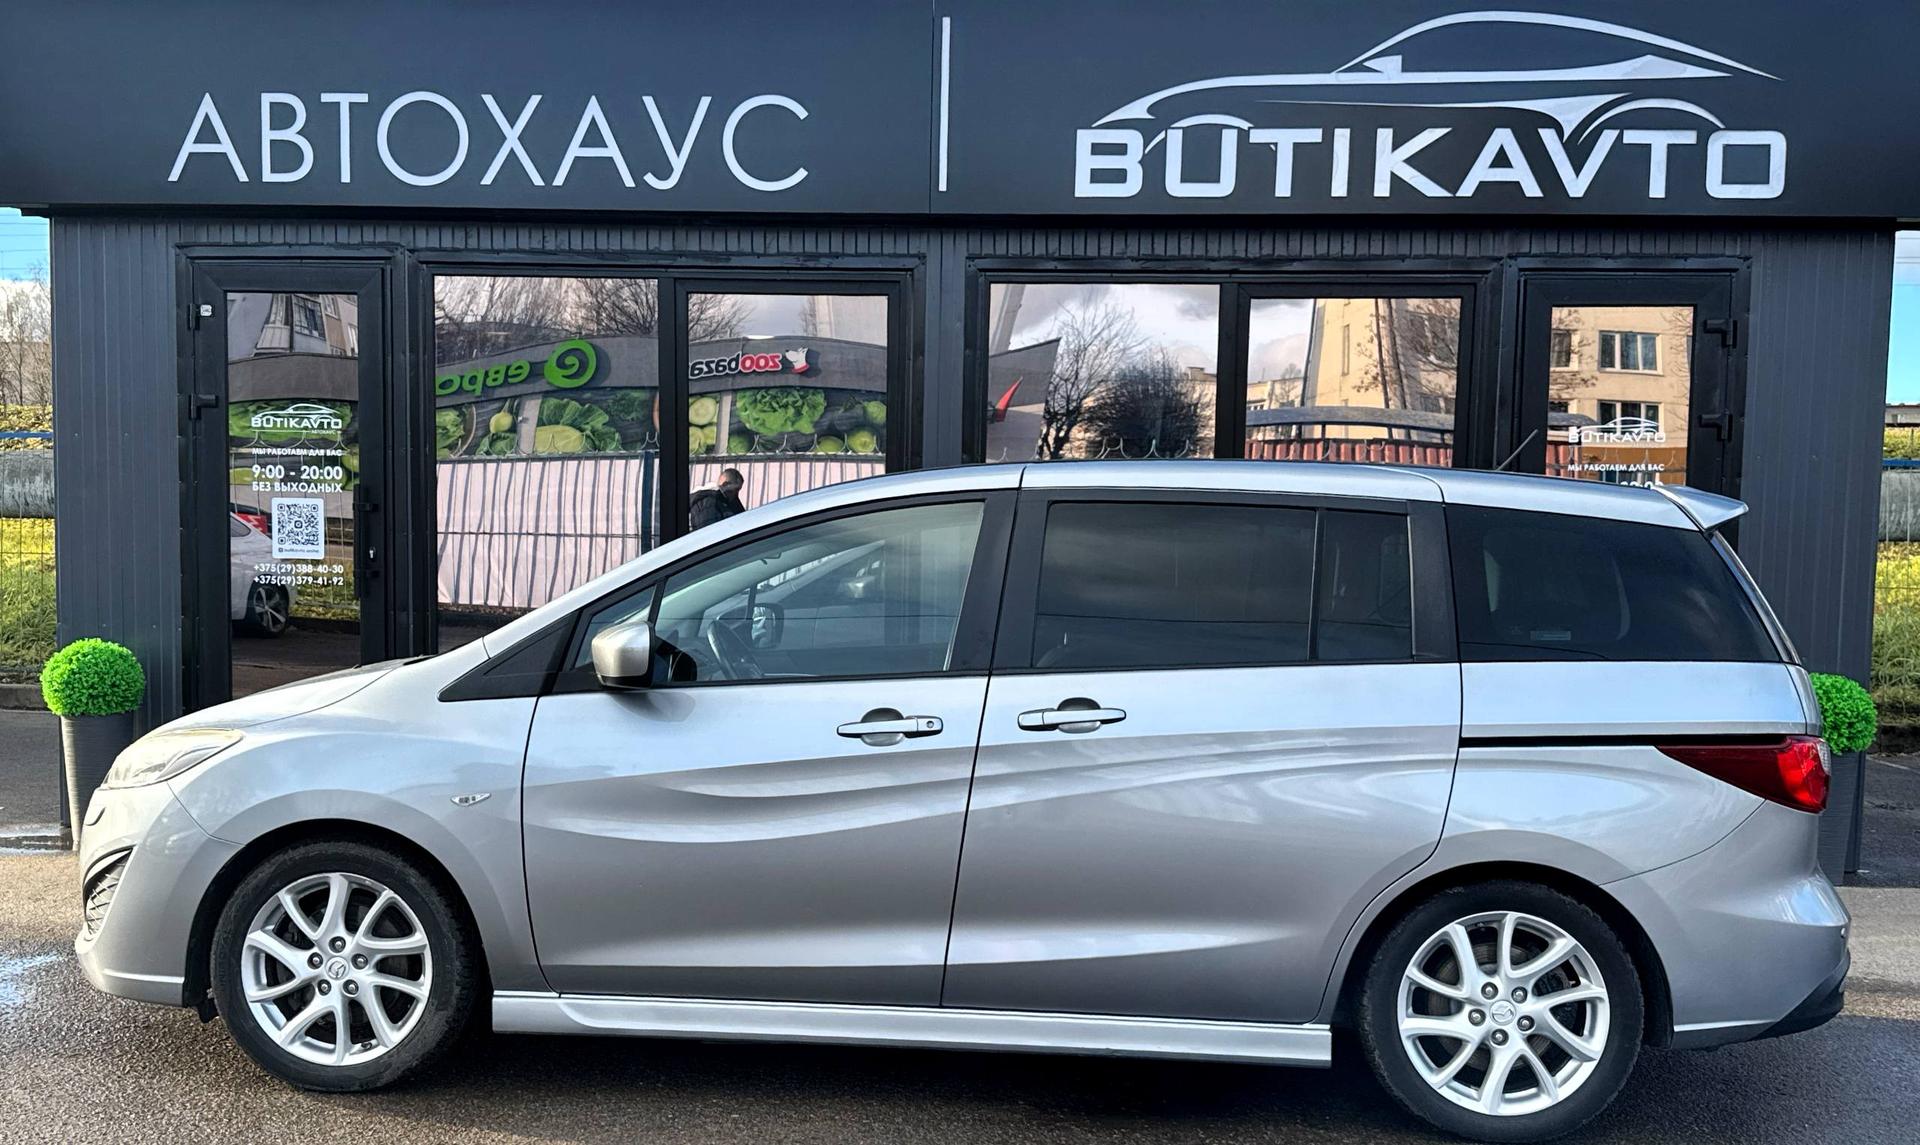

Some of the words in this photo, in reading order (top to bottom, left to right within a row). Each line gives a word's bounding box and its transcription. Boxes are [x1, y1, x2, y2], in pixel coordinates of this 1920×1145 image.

[168, 91, 810, 191] АВТОХАУС
[1074, 127, 1788, 199] BUTIKAVTO
[251, 416, 343, 429] BUTIKAVTO
[1568, 431, 1666, 443] BUTIKAVTO
[267, 448, 307, 456] РАБОТАЕМ
[308, 449, 324, 457] ДЛЯ
[326, 449, 343, 457] ВАС
[252, 464, 285, 479] 9:00
[300, 465, 343, 480] 20:00
[1567, 463, 1582, 472] МЫ
[1584, 463, 1627, 472] РАБОТАЕМ
[1629, 463, 1646, 472] ДЛЯ
[1647, 463, 1665, 471] ВАС
[252, 481, 271, 492] БЕЗ
[274, 481, 343, 493] ВЫХОДНЫХ
[253, 563, 344, 574] +375(29)388-40-30
[253, 575, 344, 586] +375(29)379-41-92
